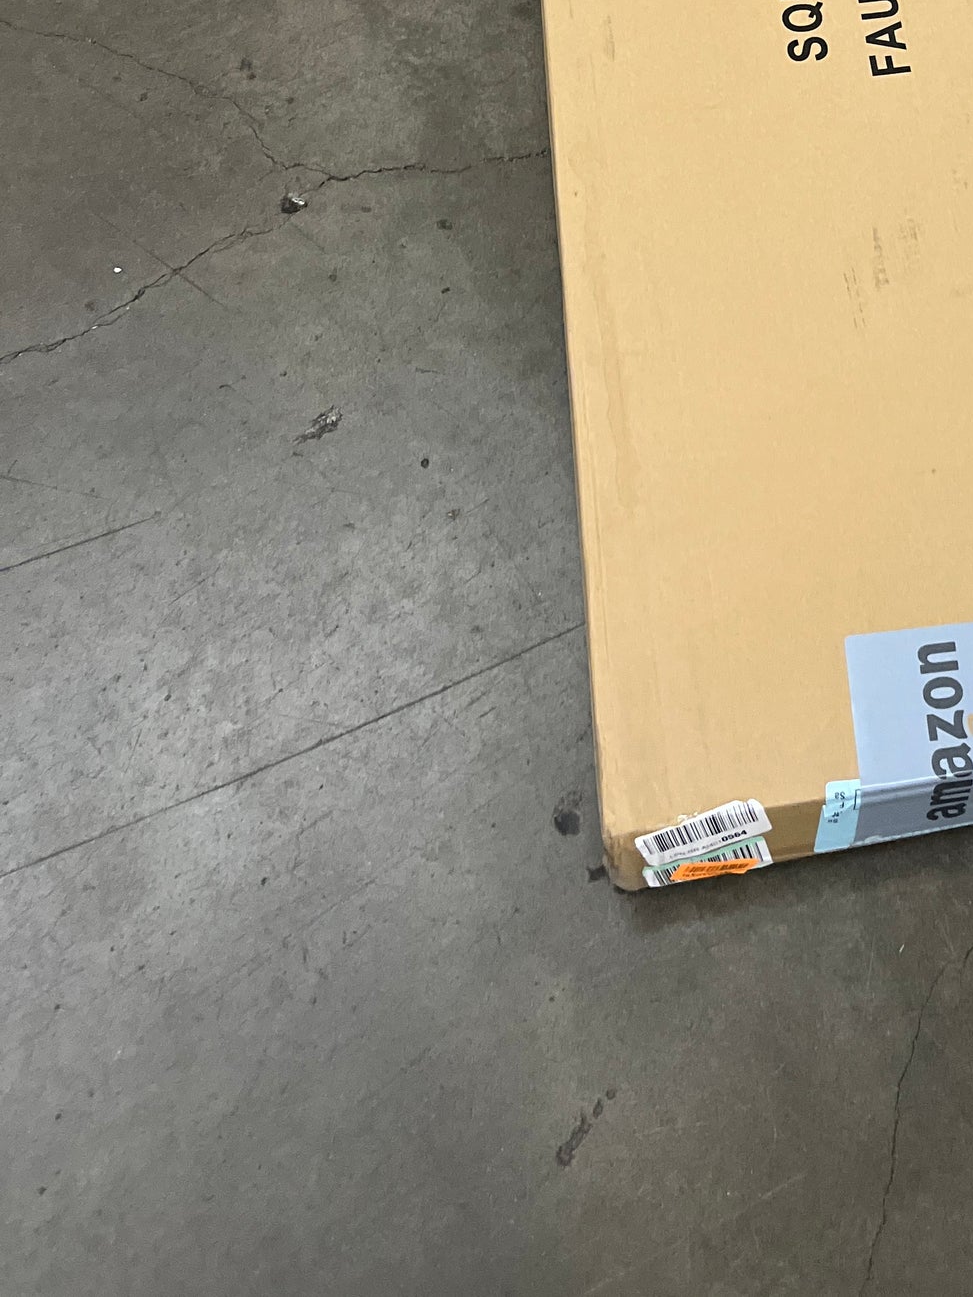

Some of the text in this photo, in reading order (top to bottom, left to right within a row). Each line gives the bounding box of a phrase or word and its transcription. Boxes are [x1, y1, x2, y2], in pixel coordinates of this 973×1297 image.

[917, 641, 973, 821] amazon
[834, 792, 846, 800] Sa
[721, 830, 748, 842] 0564
